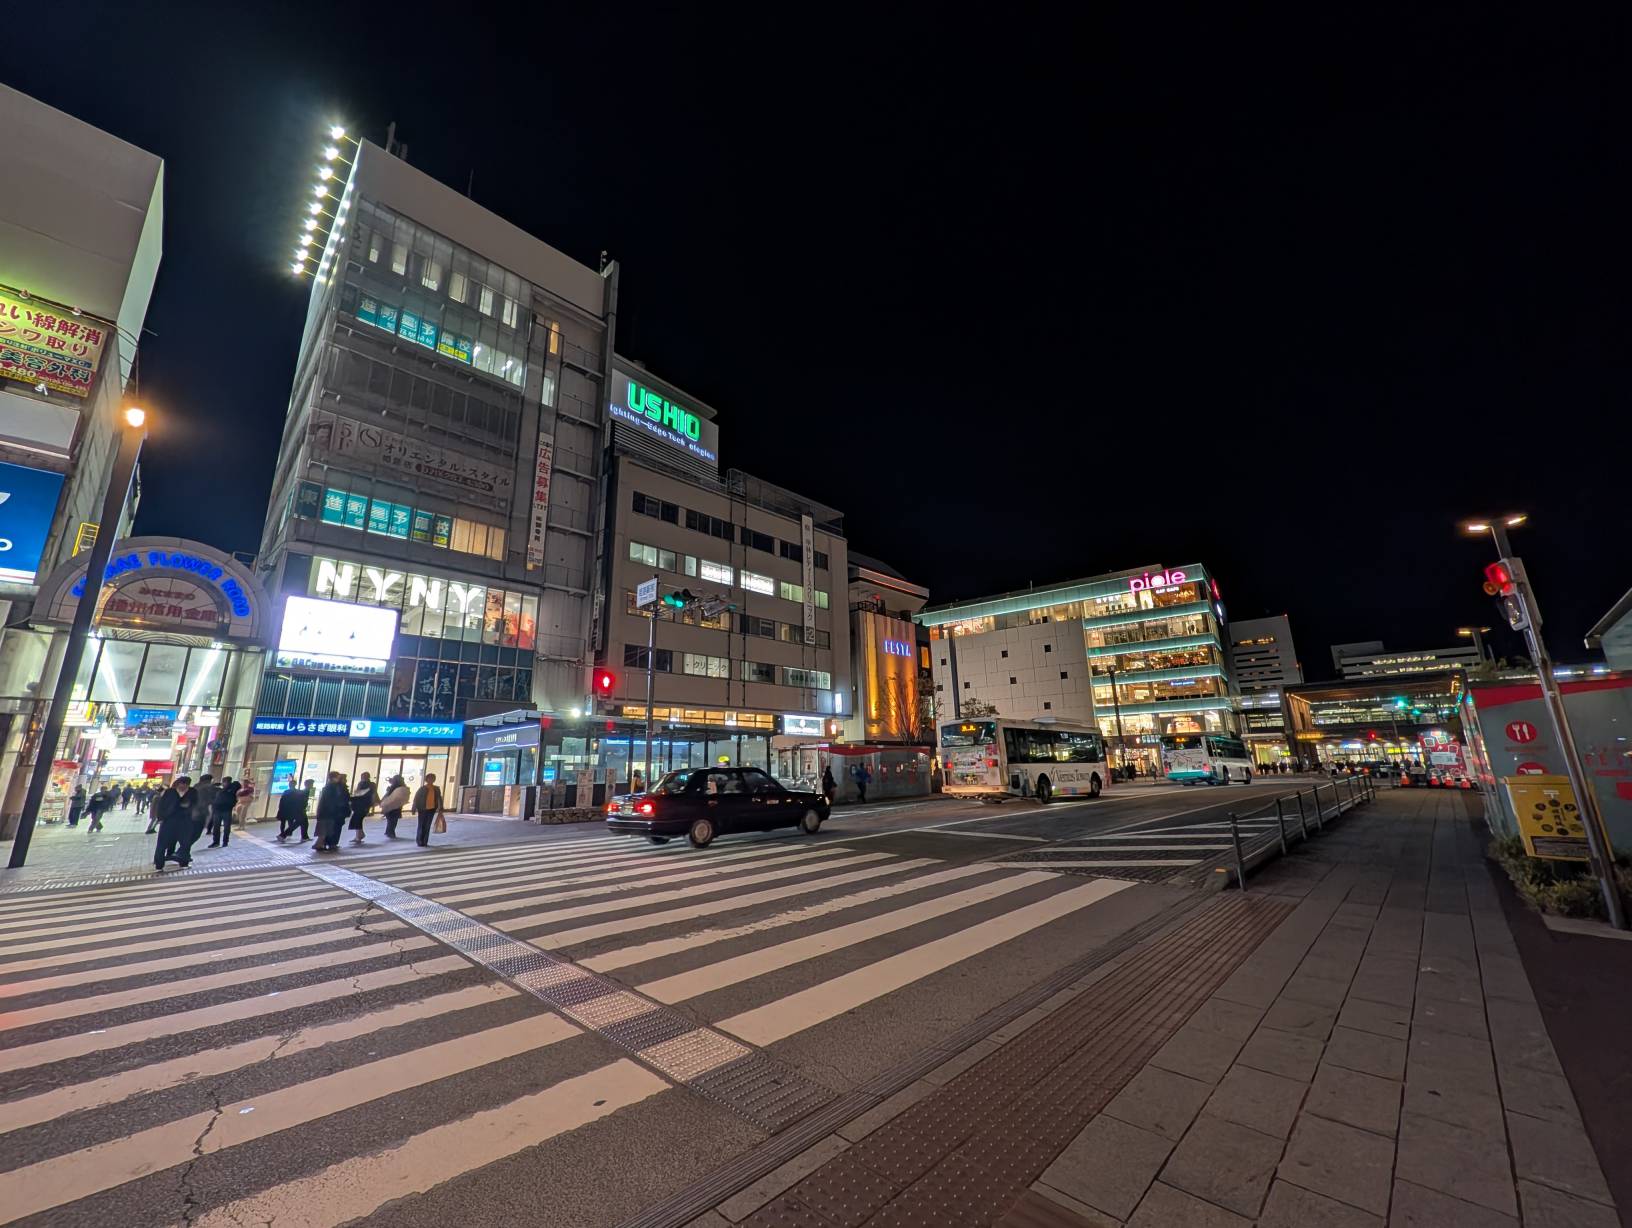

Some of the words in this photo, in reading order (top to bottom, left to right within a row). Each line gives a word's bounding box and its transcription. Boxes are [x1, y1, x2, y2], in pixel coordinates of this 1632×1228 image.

[627, 381, 702, 442] USHIO
[147, 551, 224, 582] FLOWER
[220, 577, 250, 618] ROAD
[315, 560, 483, 614] NYNY
[1130, 568, 1187, 597] piole
[286, 720, 348, 734] しらさぎ眼科
